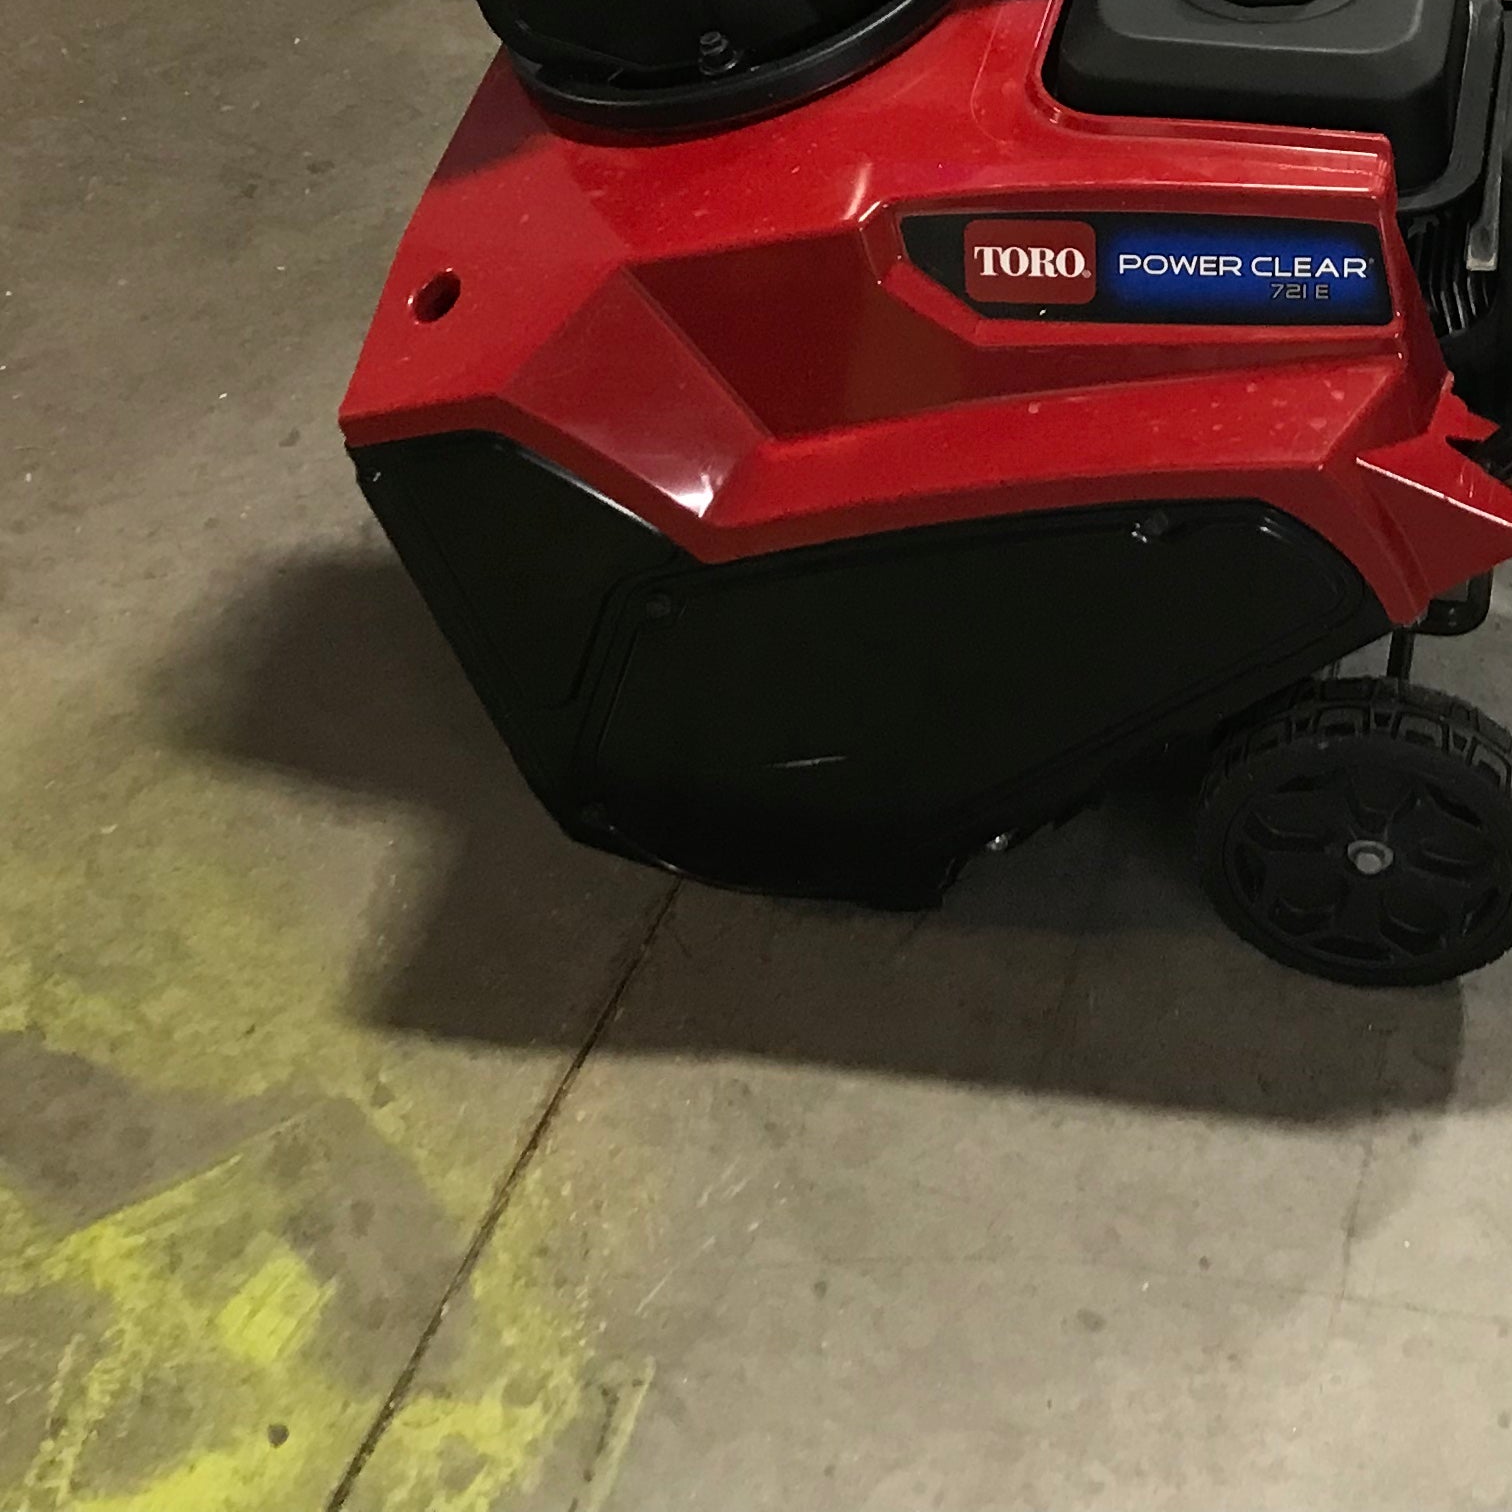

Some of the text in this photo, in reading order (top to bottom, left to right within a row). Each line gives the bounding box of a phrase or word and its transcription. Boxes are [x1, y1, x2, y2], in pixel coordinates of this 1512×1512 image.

[973, 245, 1086, 279] TORO
[1118, 253, 1368, 279] POWER CLEAR
[1270, 283, 1329, 300] 721 E
